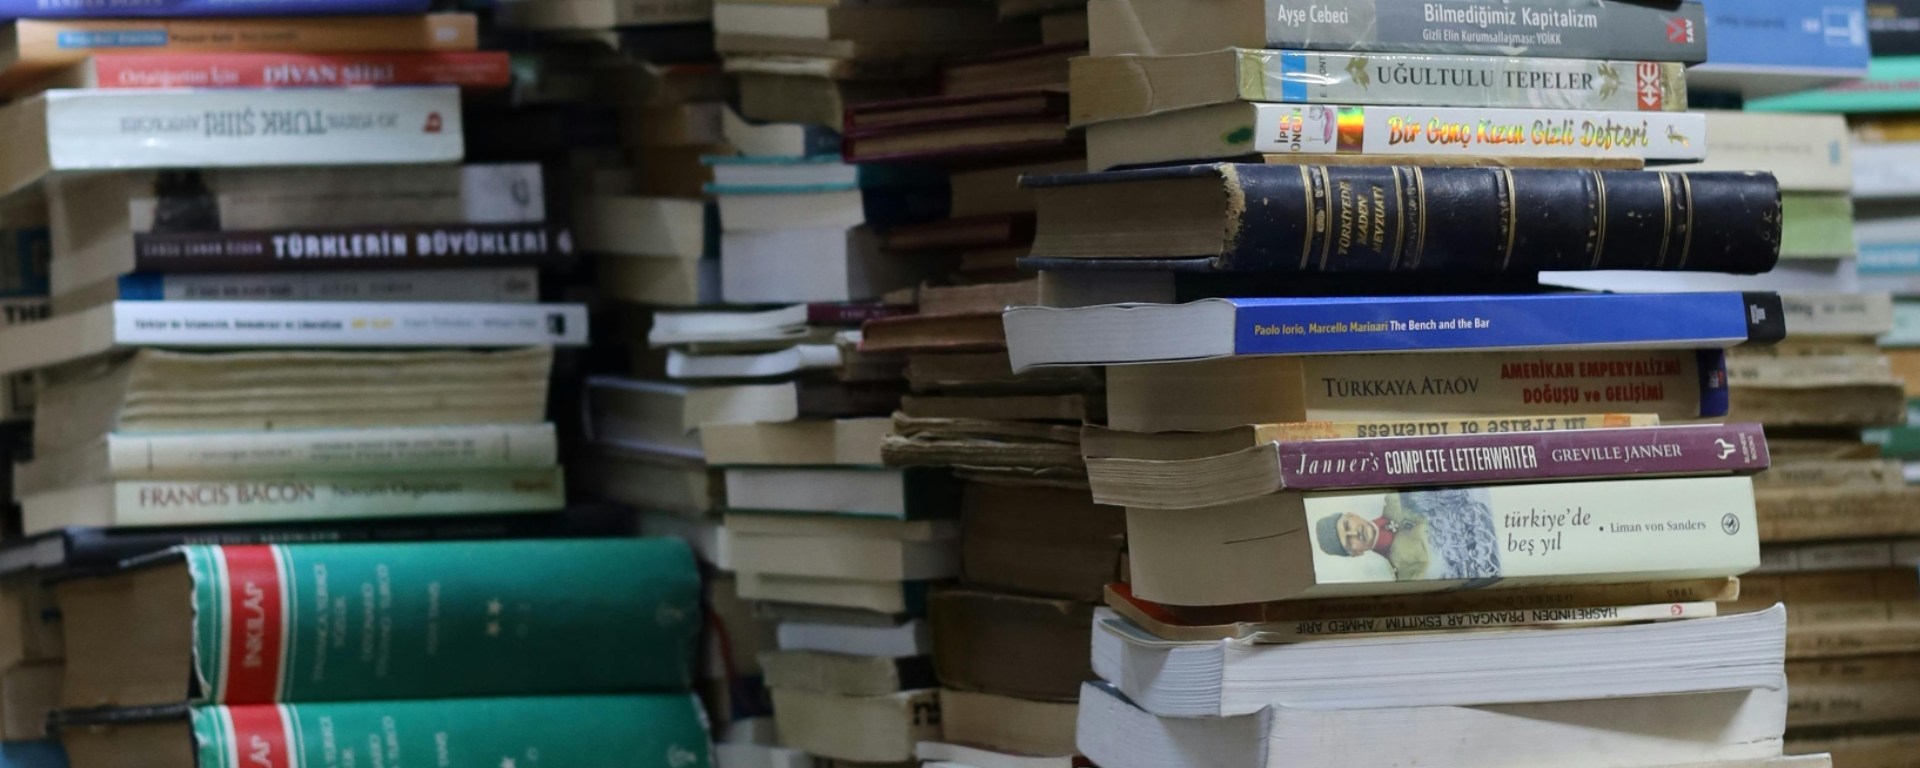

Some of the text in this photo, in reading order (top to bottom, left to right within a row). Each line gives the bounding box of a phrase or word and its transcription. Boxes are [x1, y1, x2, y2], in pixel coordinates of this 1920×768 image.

[1278, 4, 1349, 27] Ayşe Cebeci
[1424, 3, 1598, 30] Bilmediğimiz Kapitalizm
[1423, 28, 1442, 41] Gizli
[1443, 29, 1459, 42] Elin
[1685, 19, 1694, 43] SAV
[1377, 63, 1594, 91] UĞULTULU TEPELER
[1274, 112, 1290, 143] İPEK
[1290, 107, 1303, 152] ONGUN
[1388, 115, 1649, 151] Bir Genç Kızın Gizli Defteri
[1356, 193, 1369, 245] MADEN
[272, 231, 407, 259] TÜRKLERİN
[417, 229, 548, 256] BÜYÜKLERİ
[1254, 324, 1280, 336] Paolo
[1309, 322, 1348, 334] Marcello
[1350, 321, 1388, 332] Marinari
[1390, 320, 1406, 332] The
[1408, 318, 1436, 331] Bench
[1438, 318, 1456, 330] and
[1457, 317, 1473, 329] the
[1474, 317, 1490, 329] Bar
[1501, 357, 1681, 379] AMERİKAN EMPERYALİZMİ
[1322, 375, 1479, 398] TÜRKKAYA ATAÖV
[1523, 381, 1664, 405] DOĞUŞU ve GELİŞİMİ
[1296, 444, 1683, 476] Janner's COMPLETE LETTERWRITER GREVILLE JANNER
[138, 483, 316, 509] FRANCIS BACON
[1504, 506, 1591, 533] türkiye'de
[1610, 520, 1707, 533] Liman von Sanders
[1507, 533, 1562, 556] beş yıl
[1448, 611, 1525, 626] PRANGALAR
